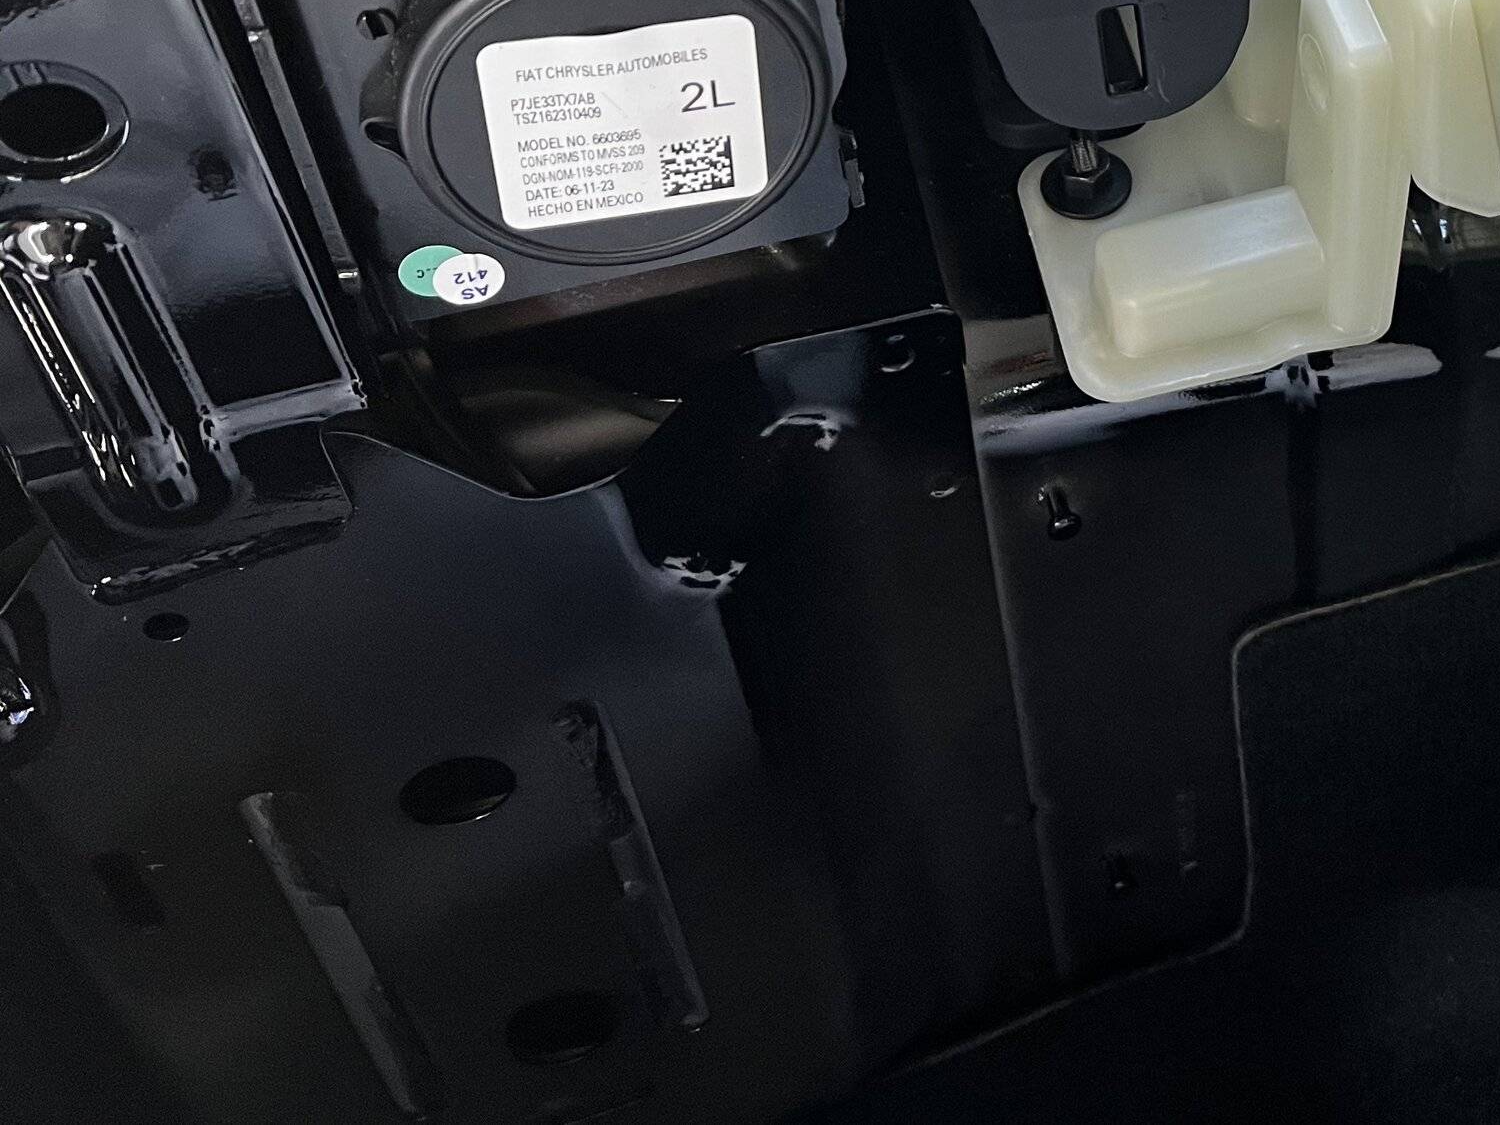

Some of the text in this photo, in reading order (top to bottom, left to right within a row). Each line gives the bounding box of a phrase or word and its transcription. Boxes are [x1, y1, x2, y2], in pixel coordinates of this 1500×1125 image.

[515, 47, 709, 82] FIAT CHRYSLER AUTOMOBILES
[510, 92, 596, 112] P7JE33TX7AB
[680, 79, 736, 113] 2L
[514, 106, 602, 125] TSZ162310409
[518, 137, 564, 153] MODEL
[566, 134, 590, 148] NO.
[520, 143, 645, 168] CONFORMS TO MVSS 209
[525, 179, 615, 202] DATE: 06-11-23
[528, 191, 644, 217] HECHO EN MEXICO
[453, 269, 488, 285] 412
[461, 284, 489, 300] AS
